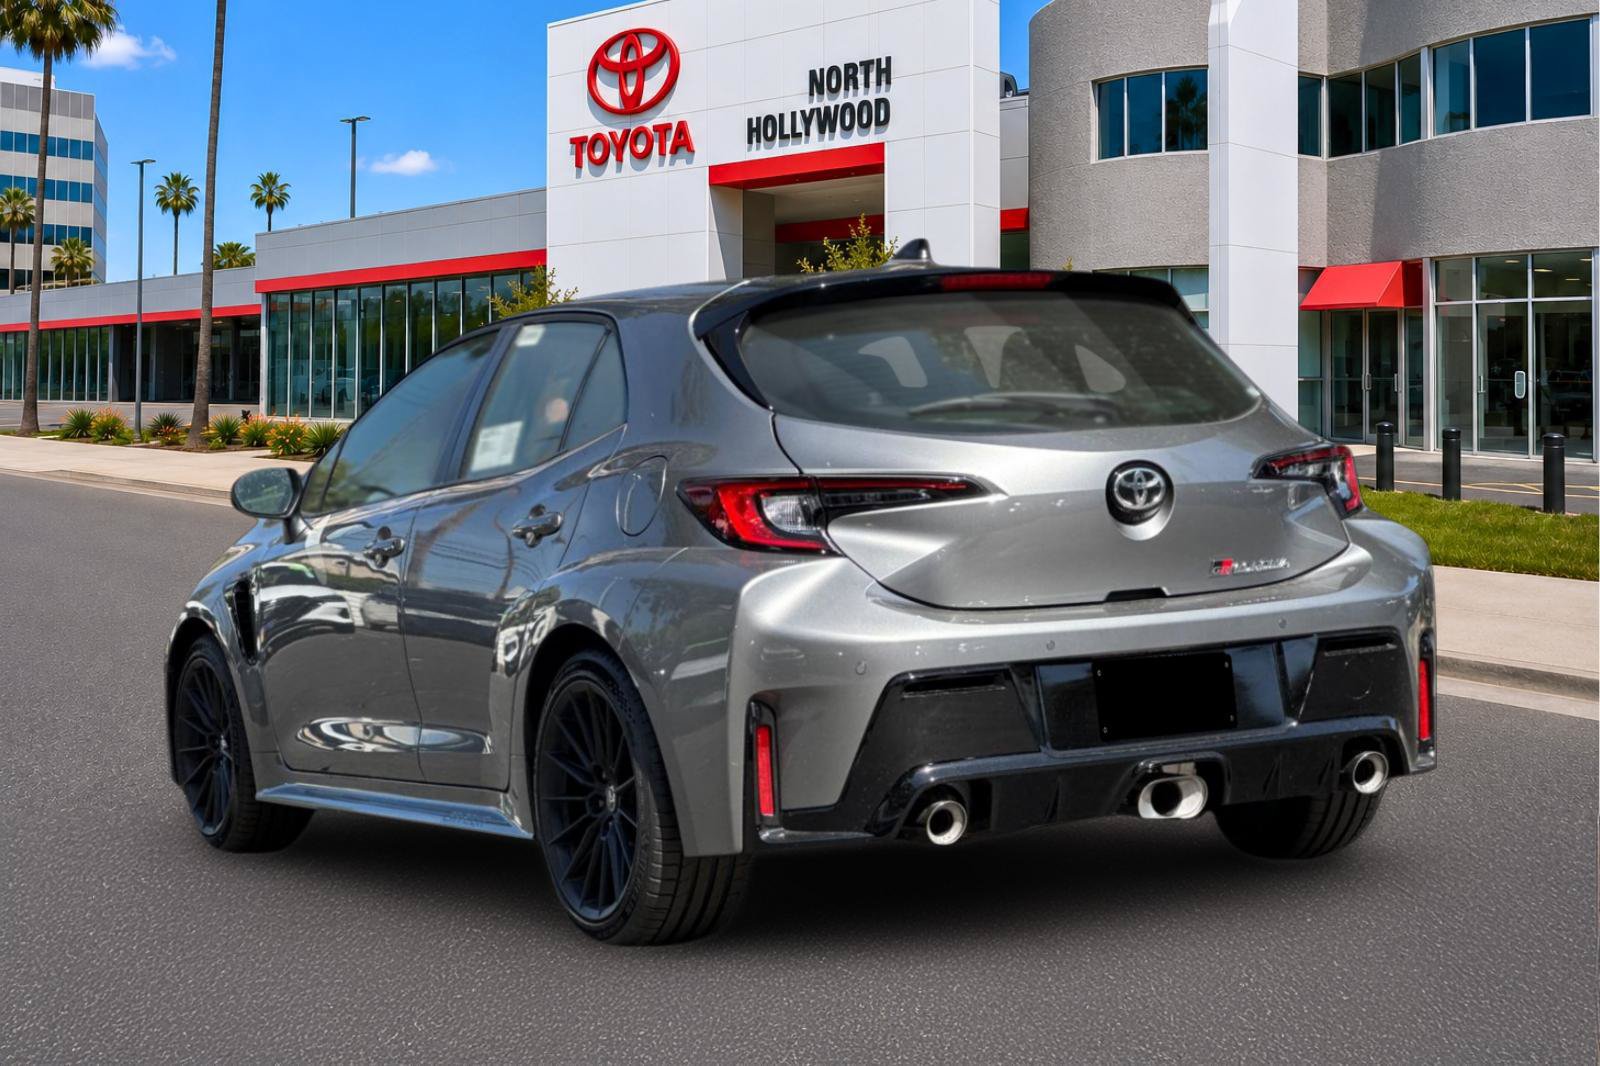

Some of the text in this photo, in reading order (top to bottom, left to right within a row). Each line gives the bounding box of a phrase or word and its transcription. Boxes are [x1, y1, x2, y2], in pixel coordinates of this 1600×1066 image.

[809, 56, 892, 96] NORTH
[570, 121, 695, 168] TOYOTA
[747, 98, 891, 145] HOLLYWOOD
